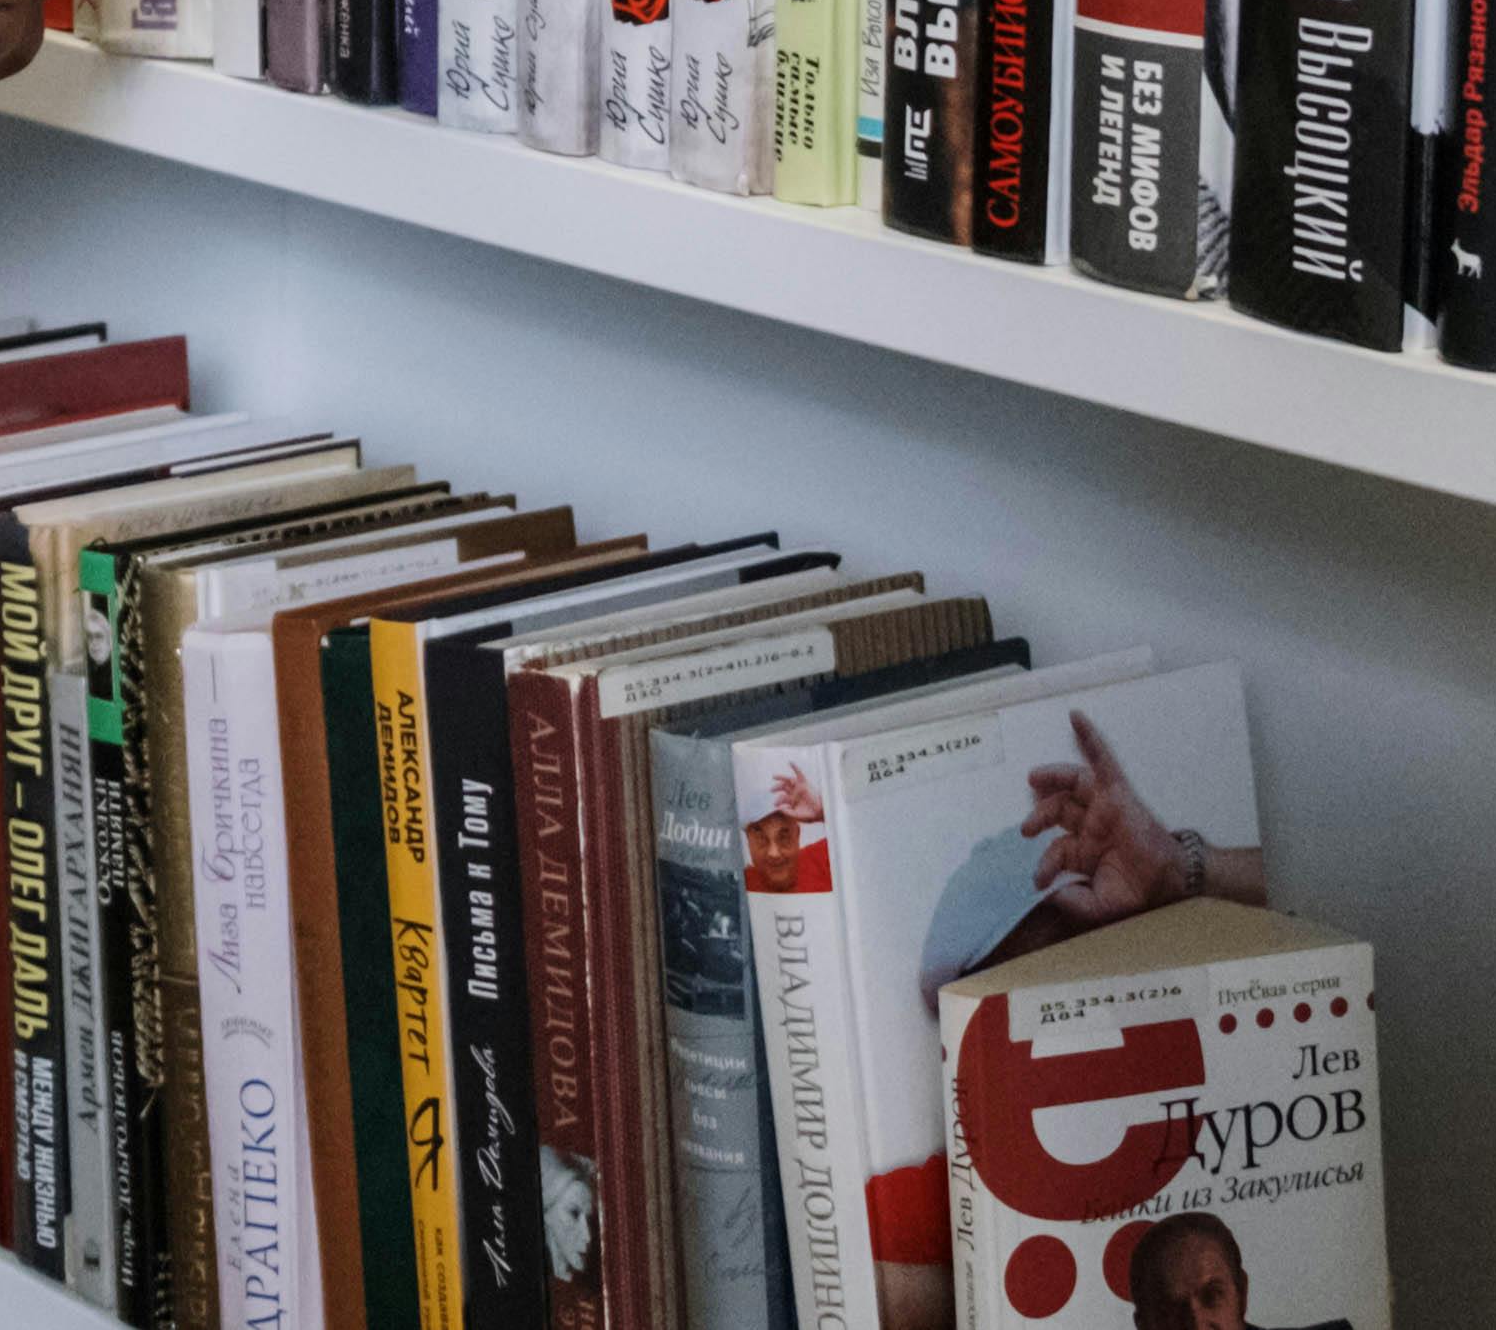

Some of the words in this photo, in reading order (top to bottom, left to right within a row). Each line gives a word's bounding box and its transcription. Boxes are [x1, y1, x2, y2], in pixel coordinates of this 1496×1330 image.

[447, 19, 479, 99] Юрий
[480, 15, 514, 111] Сушко
[1131, 59, 1164, 117] БЕЗ
[1128, 130, 1163, 252] МИФОВ
[0, 561, 47, 664] МОЙ
[3, 665, 43, 777] ДРУГ
[377, 702, 402, 846] ДЕМИДОВ
[528, 710, 562, 839] АЛЛА
[397, 689, 426, 866] АЛЕКСАНДР
[458, 778, 497, 850] Тому
[659, 811, 732, 849] Додин
[8, 819, 45, 924] ОЛЕГ
[57, 721, 96, 1023] ДЖИГАРХАНЯН
[239, 756, 269, 913] навсегда
[10, 931, 49, 1041] ДАЛЬ
[393, 915, 434, 1078] Квартет
[467, 888, 499, 1000] Письма
[536, 856, 580, 1131] ДЕМИДОВА
[31, 1056, 55, 1141] МЕЖДУ
[64, 1023, 105, 1136] Армен
[1292, 1045, 1362, 1082] Лев
[1156, 1090, 1368, 1176] Дуров
[34, 1143, 58, 1249] ЖИЗНЬЮ
[955, 1190, 977, 1251] Лев
